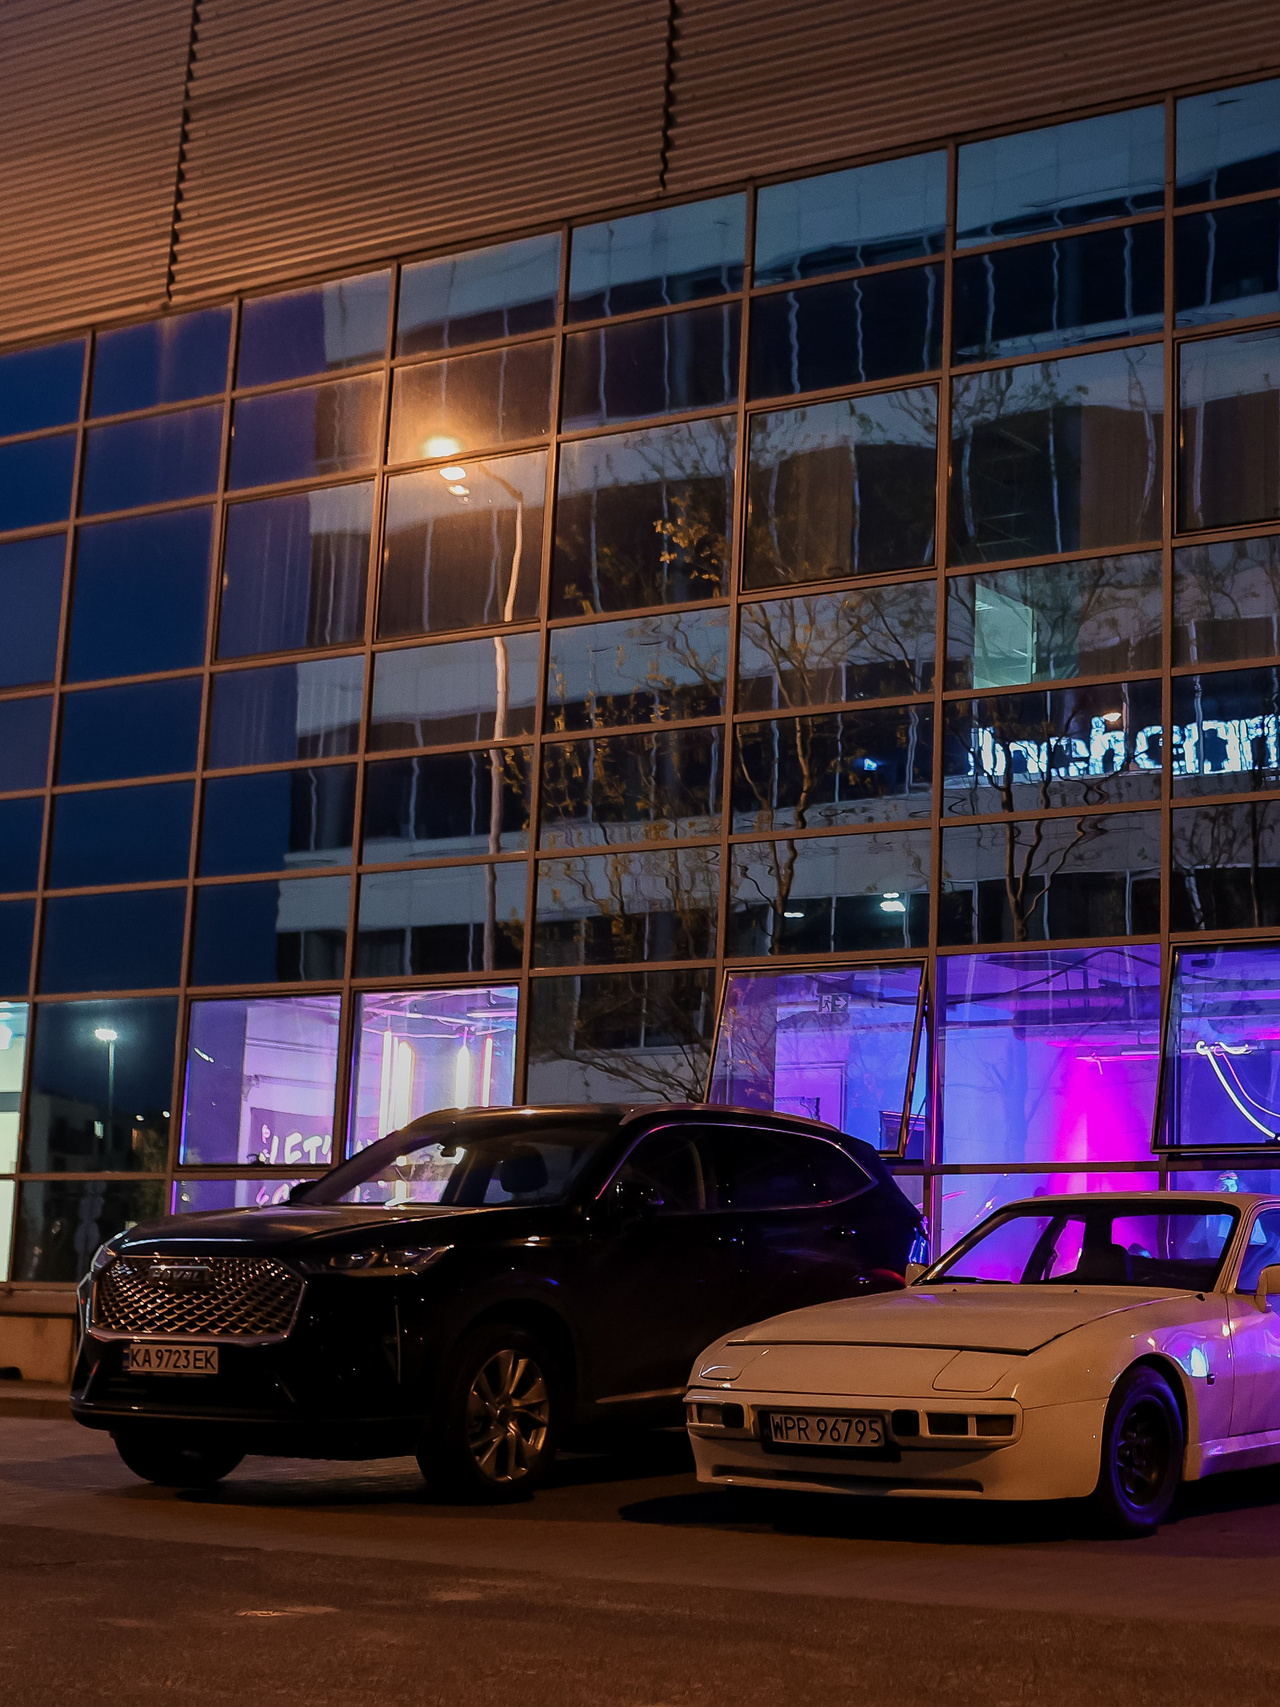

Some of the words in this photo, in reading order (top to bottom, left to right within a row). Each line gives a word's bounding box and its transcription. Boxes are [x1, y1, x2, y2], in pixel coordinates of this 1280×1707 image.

[131, 1349, 152, 1368] KA
[155, 1349, 191, 1369] 9723
[193, 1350, 216, 1370] EK
[771, 1416, 810, 1441] WPR
[816, 1418, 882, 1444] 96795
